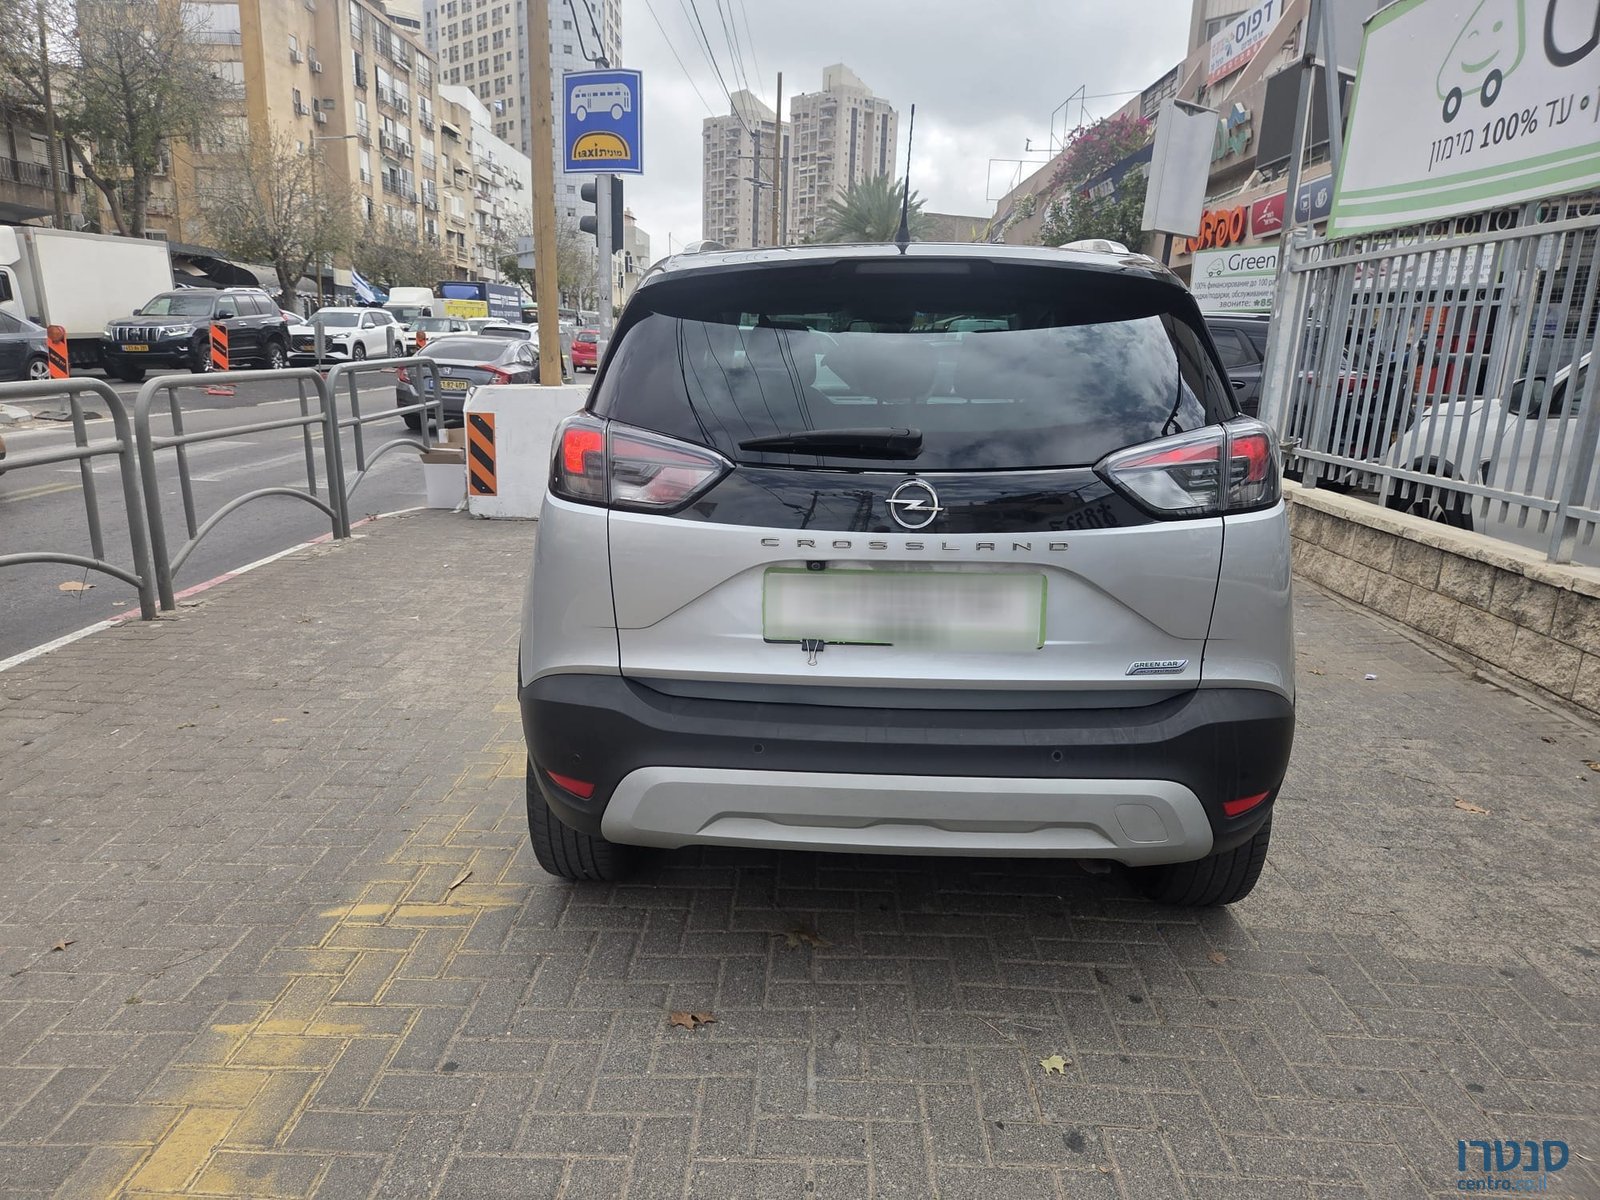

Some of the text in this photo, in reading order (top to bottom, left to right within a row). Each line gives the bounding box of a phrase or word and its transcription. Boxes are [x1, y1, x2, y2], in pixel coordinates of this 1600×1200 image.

[1235, 0, 1273, 43] דפוס
[1546, 94, 1574, 127] עד
[1480, 106, 1538, 149] 100%
[578, 143, 622, 157] taxi מונית
[1428, 129, 1474, 172] מימון
[1228, 253, 1276, 271] Green
[1219, 300, 1250, 308] звоните:
[761, 537, 1069, 552] CROSSLAND
